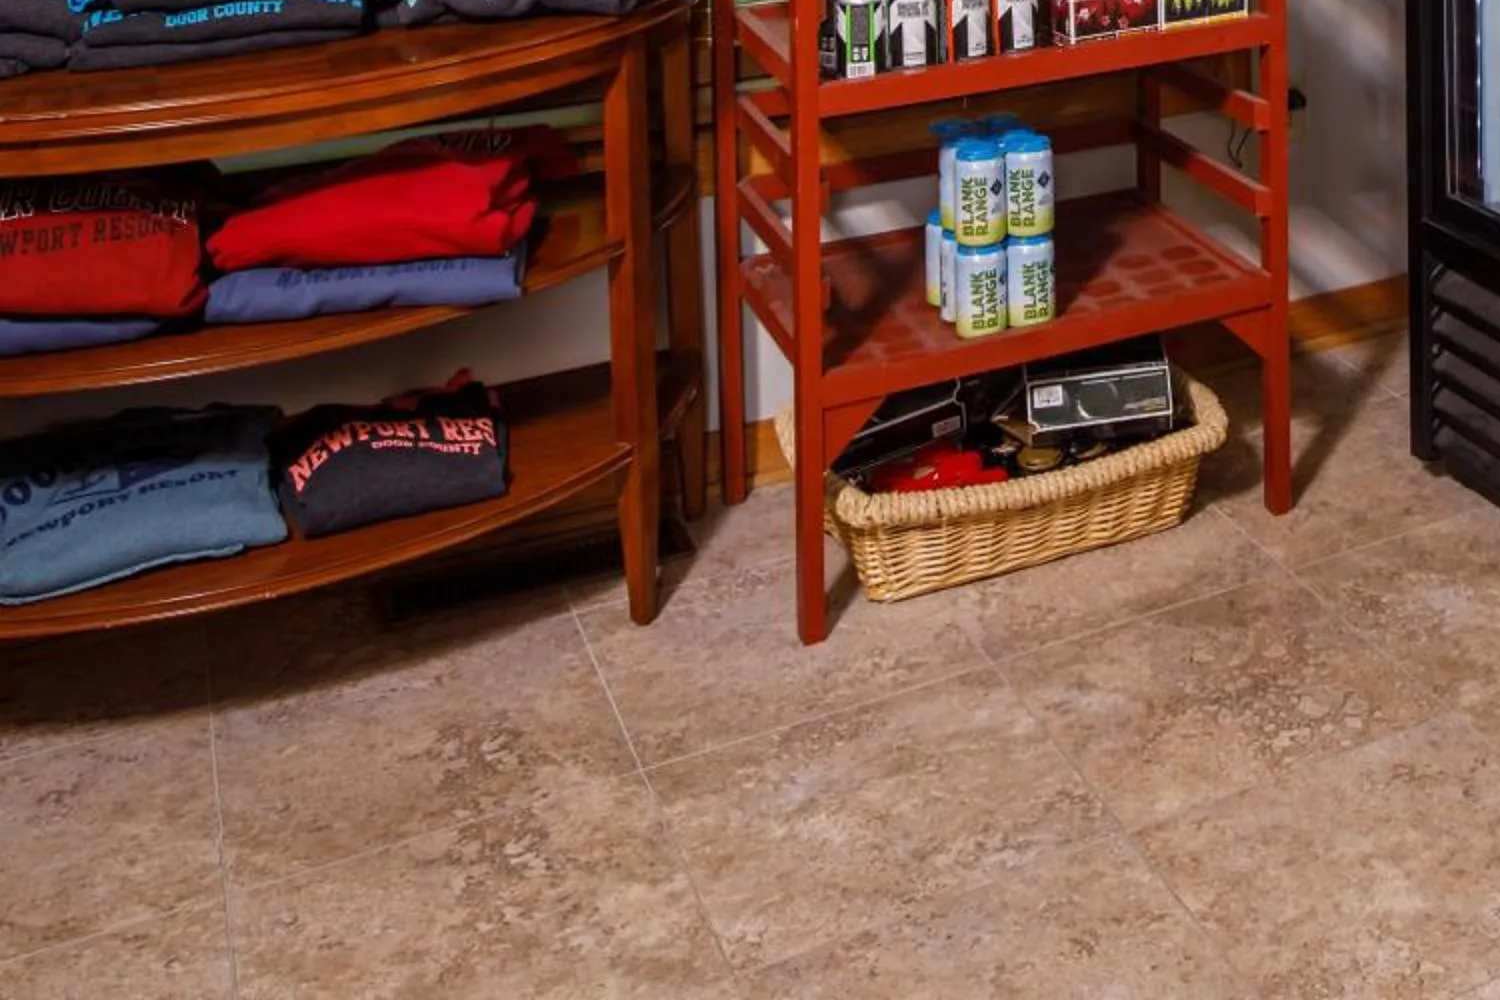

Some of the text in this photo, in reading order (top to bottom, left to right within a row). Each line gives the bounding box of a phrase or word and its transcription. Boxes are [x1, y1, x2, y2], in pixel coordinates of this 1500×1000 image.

[164, 0, 285, 28] DOOR COUNTY
[960, 176, 976, 237] BLANK
[975, 176, 989, 237] RANGE
[1007, 169, 1021, 227] BLANK
[1021, 168, 1036, 228] RANGE
[0, 222, 85, 258] WPORT
[970, 272, 986, 331] BLANK
[984, 268, 998, 329] RANGE
[1023, 263, 1038, 320] BLANK
[288, 420, 430, 493] NEWPORT
